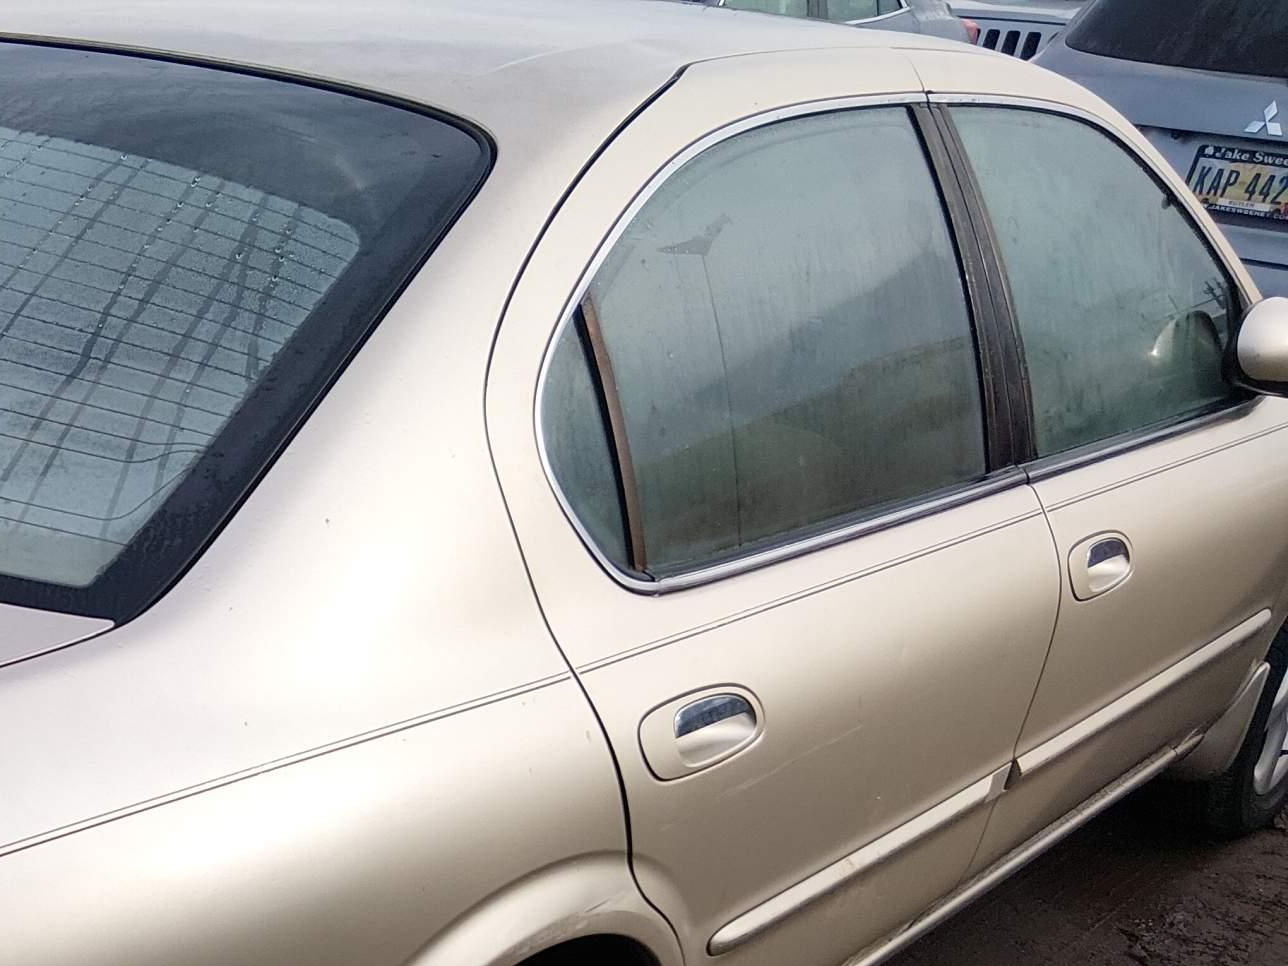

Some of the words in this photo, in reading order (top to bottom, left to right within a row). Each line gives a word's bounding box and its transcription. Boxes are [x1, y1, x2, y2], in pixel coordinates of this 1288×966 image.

[1215, 146, 1250, 161] Jake
[1193, 164, 1241, 198] KAP
[1244, 172, 1288, 205] 442
